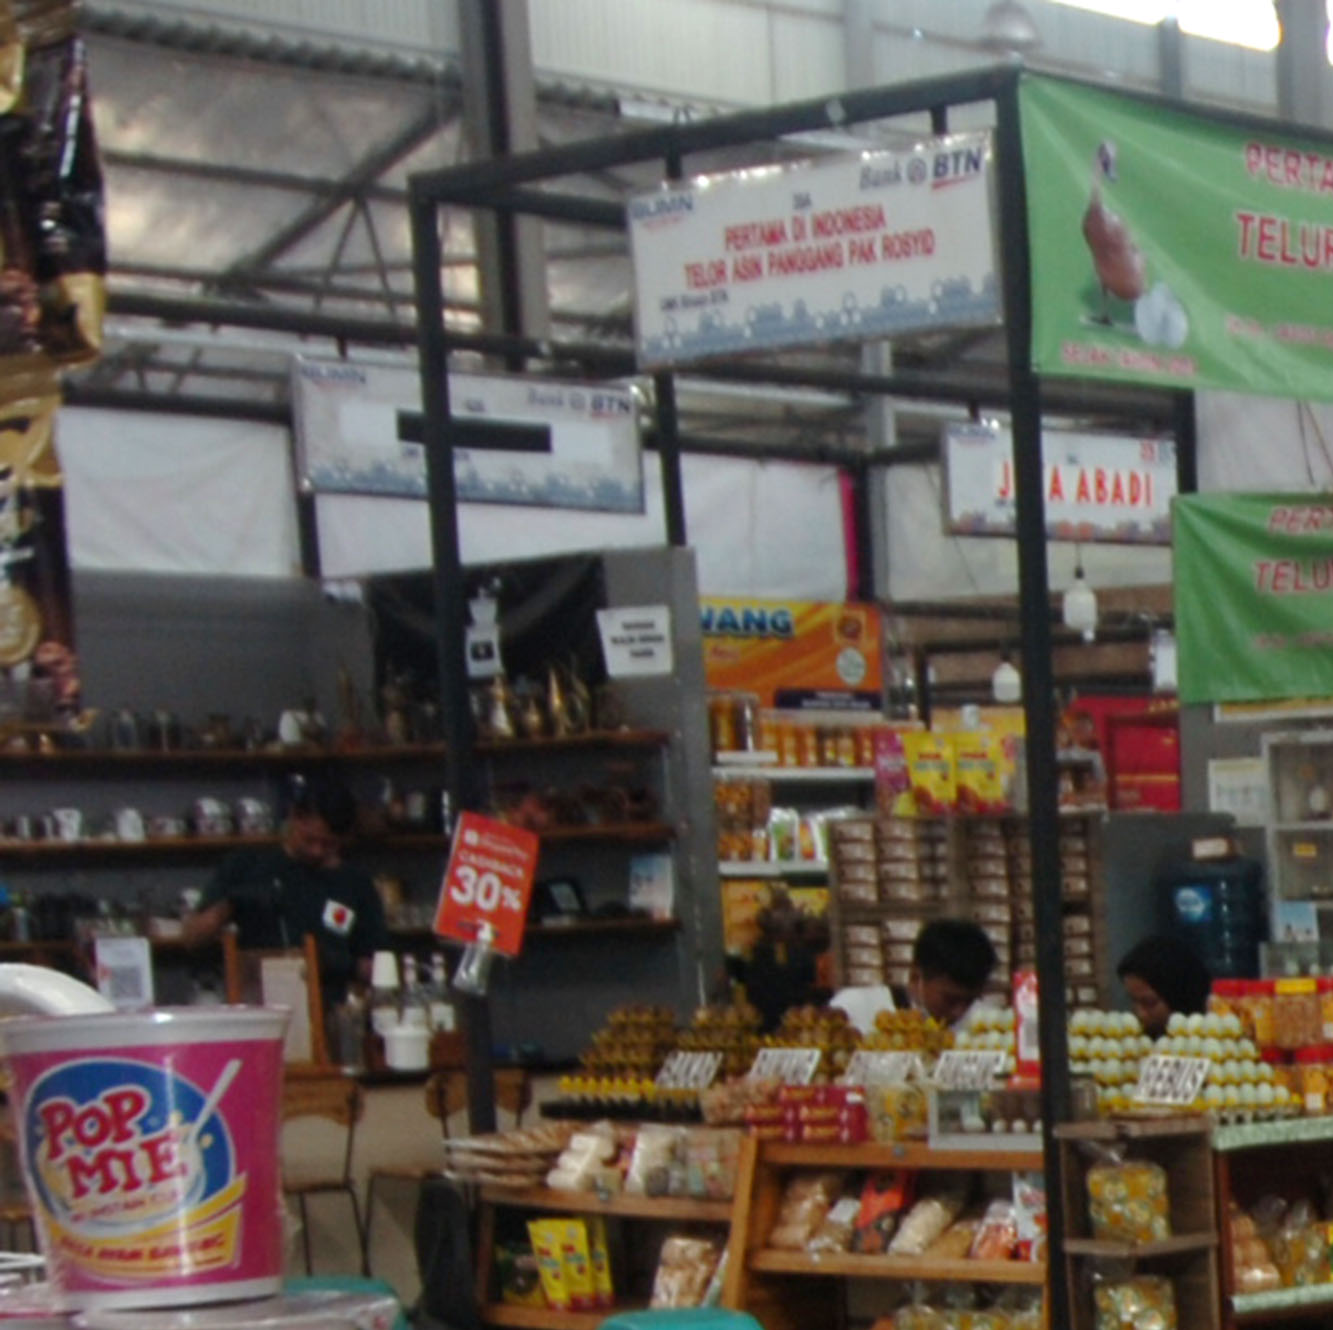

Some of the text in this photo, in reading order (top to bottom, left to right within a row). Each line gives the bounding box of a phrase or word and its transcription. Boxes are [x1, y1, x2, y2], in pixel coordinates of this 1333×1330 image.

[932, 150, 982, 180] BTN
[725, 204, 886, 251] PERTAMA DI INDONESIA
[685, 261, 728, 290] TELOR
[733, 254, 763, 283] ASIN
[769, 243, 843, 280] PANGGANG
[850, 239, 877, 265] PAK
[1076, 467, 1154, 508] ABADI
[450, 864, 522, 912] 30%
[40, 1089, 146, 1162] POP
[66, 1134, 188, 1199] MIE
